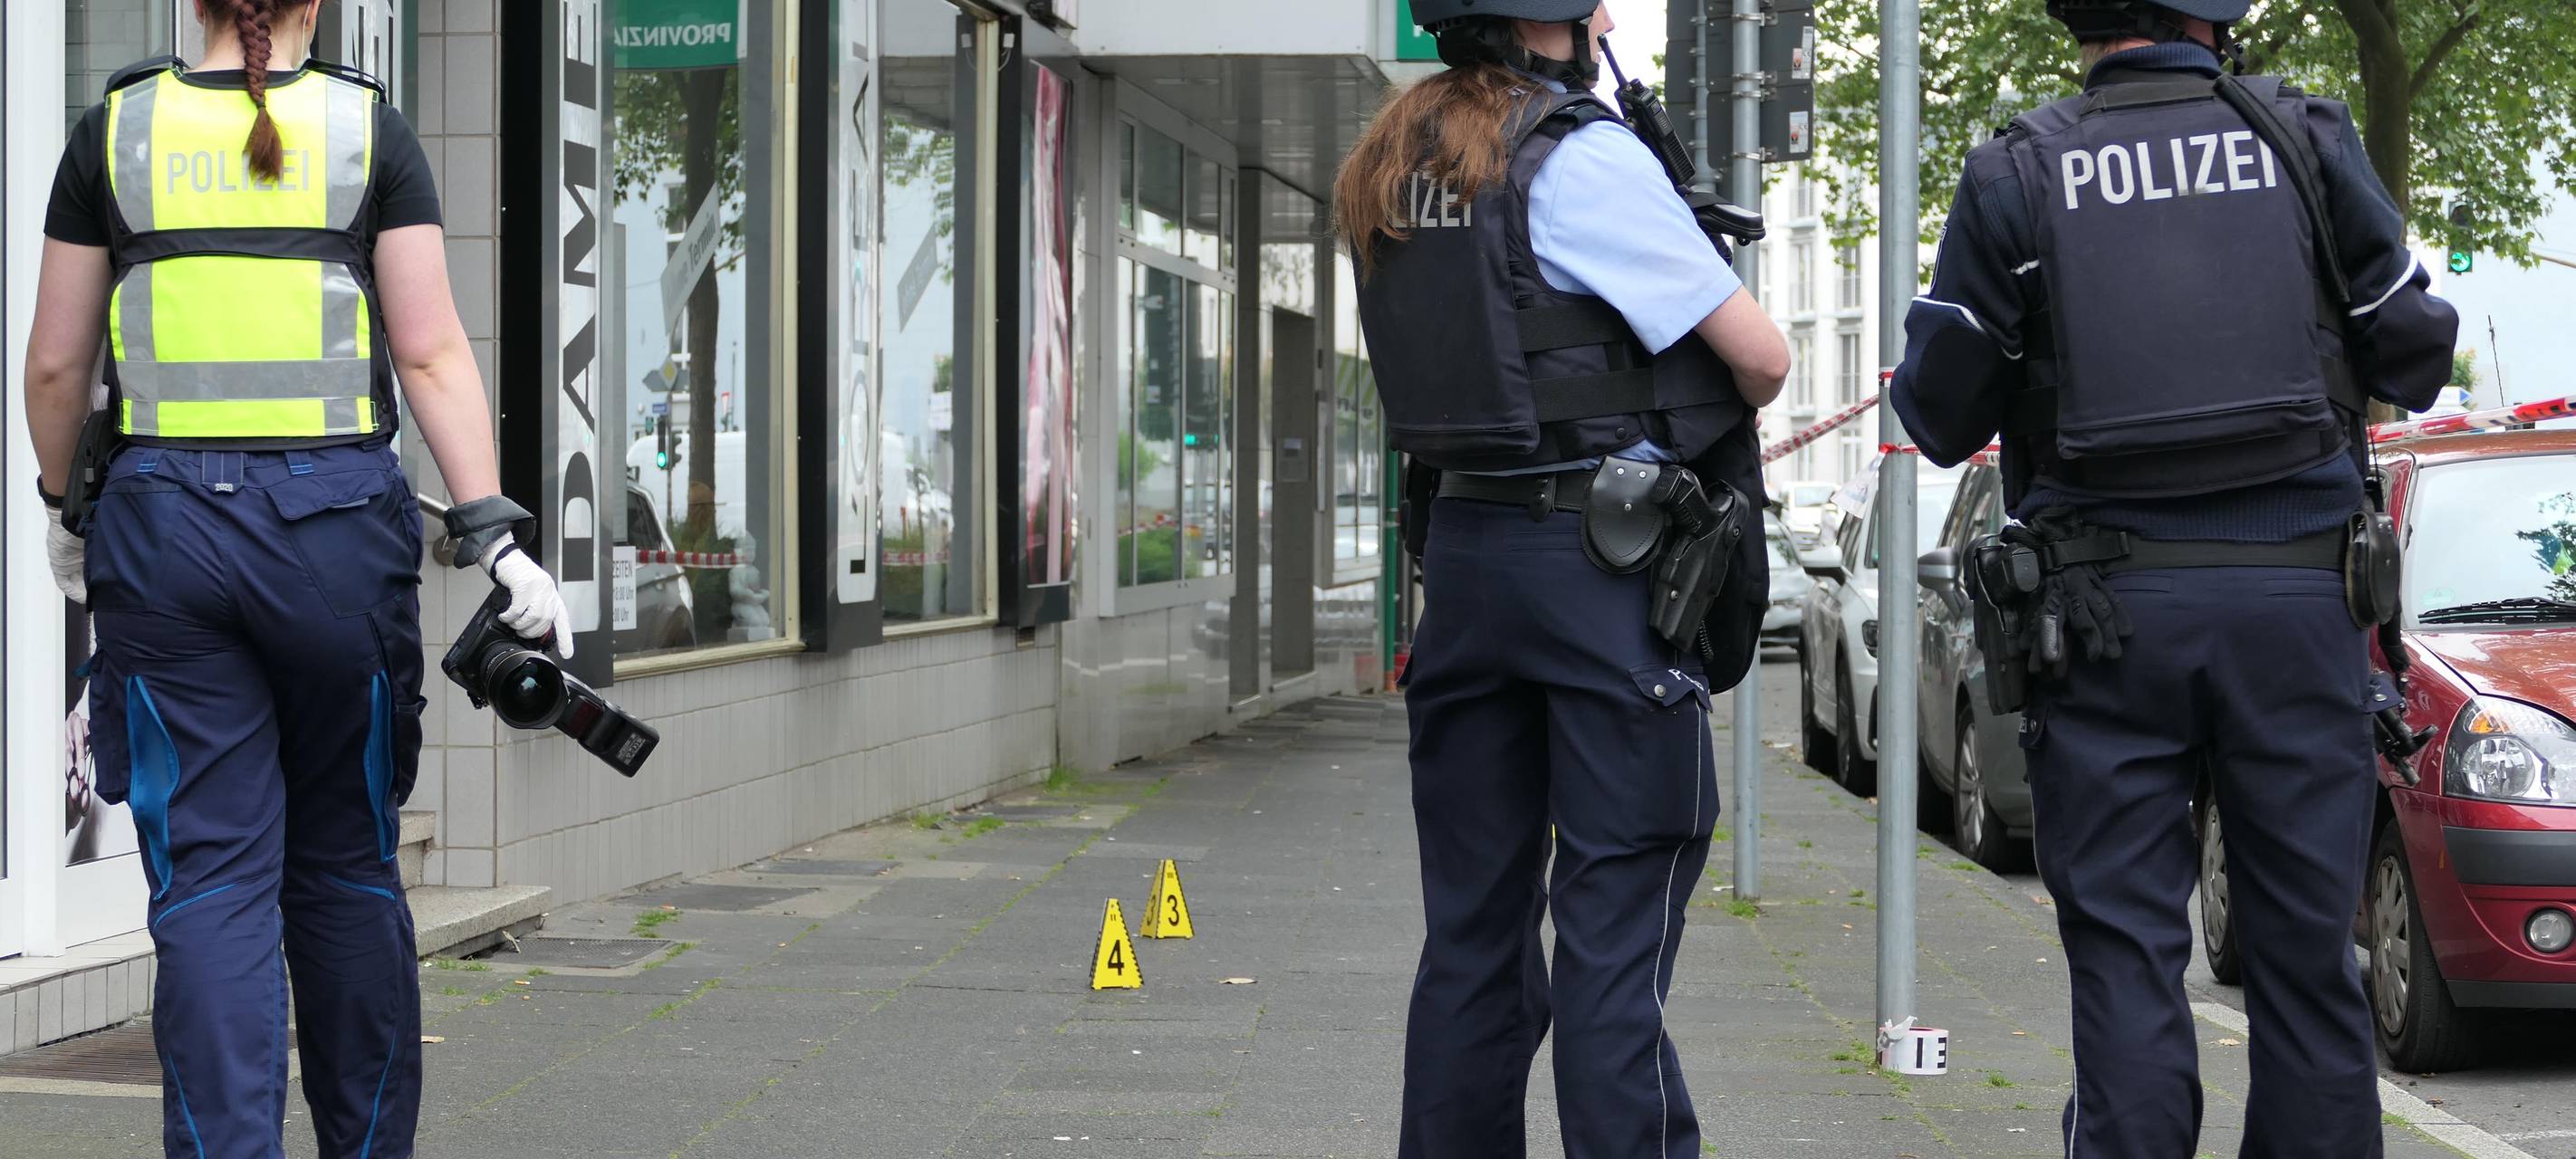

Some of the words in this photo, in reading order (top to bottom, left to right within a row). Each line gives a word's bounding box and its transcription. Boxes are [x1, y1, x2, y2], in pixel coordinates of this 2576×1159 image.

[2061, 130, 2276, 209] POLIZEI
[1167, 895, 1180, 926] 3
[1107, 939, 1125, 976] 4
